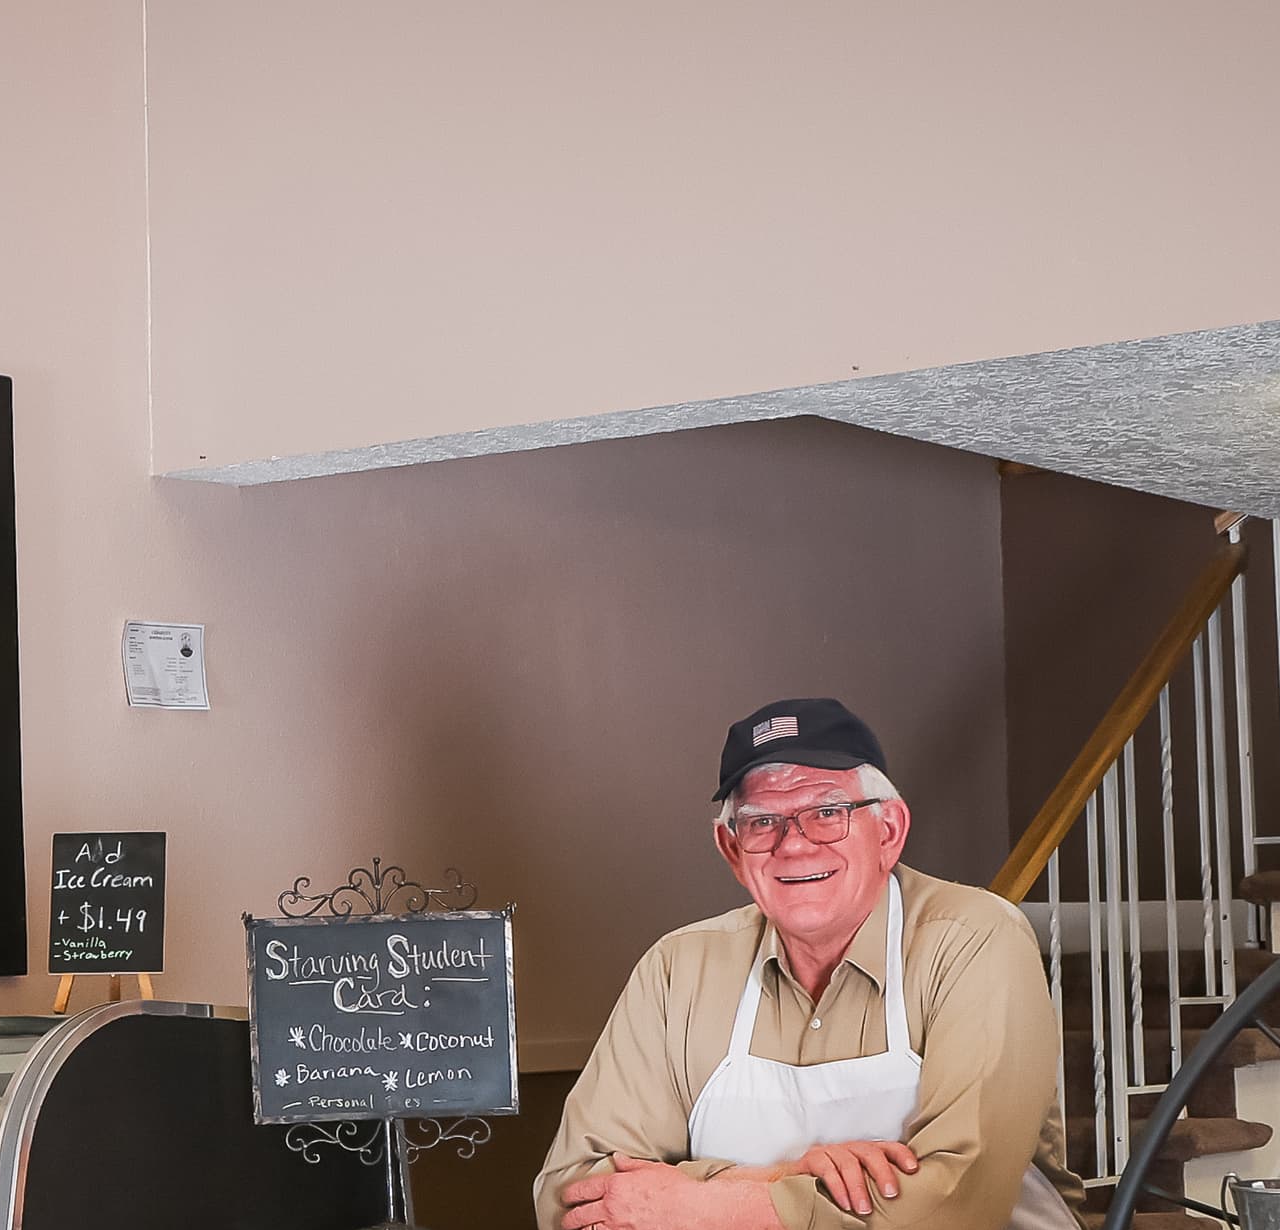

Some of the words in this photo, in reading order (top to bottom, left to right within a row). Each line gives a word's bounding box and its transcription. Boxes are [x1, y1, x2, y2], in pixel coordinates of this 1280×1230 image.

[54, 869, 86, 889] Ice
[90, 867, 153, 888] Cream
[77, 901, 147, 933] $1.49
[265, 939, 380, 991] Starving
[386, 934, 494, 978] Student
[307, 1024, 397, 1053] Chocolate
[416, 1026, 495, 1051] Coconut
[296, 1064, 381, 1084] Banana
[406, 1067, 472, 1088] Lemon
[308, 1095, 374, 1109] Personal
